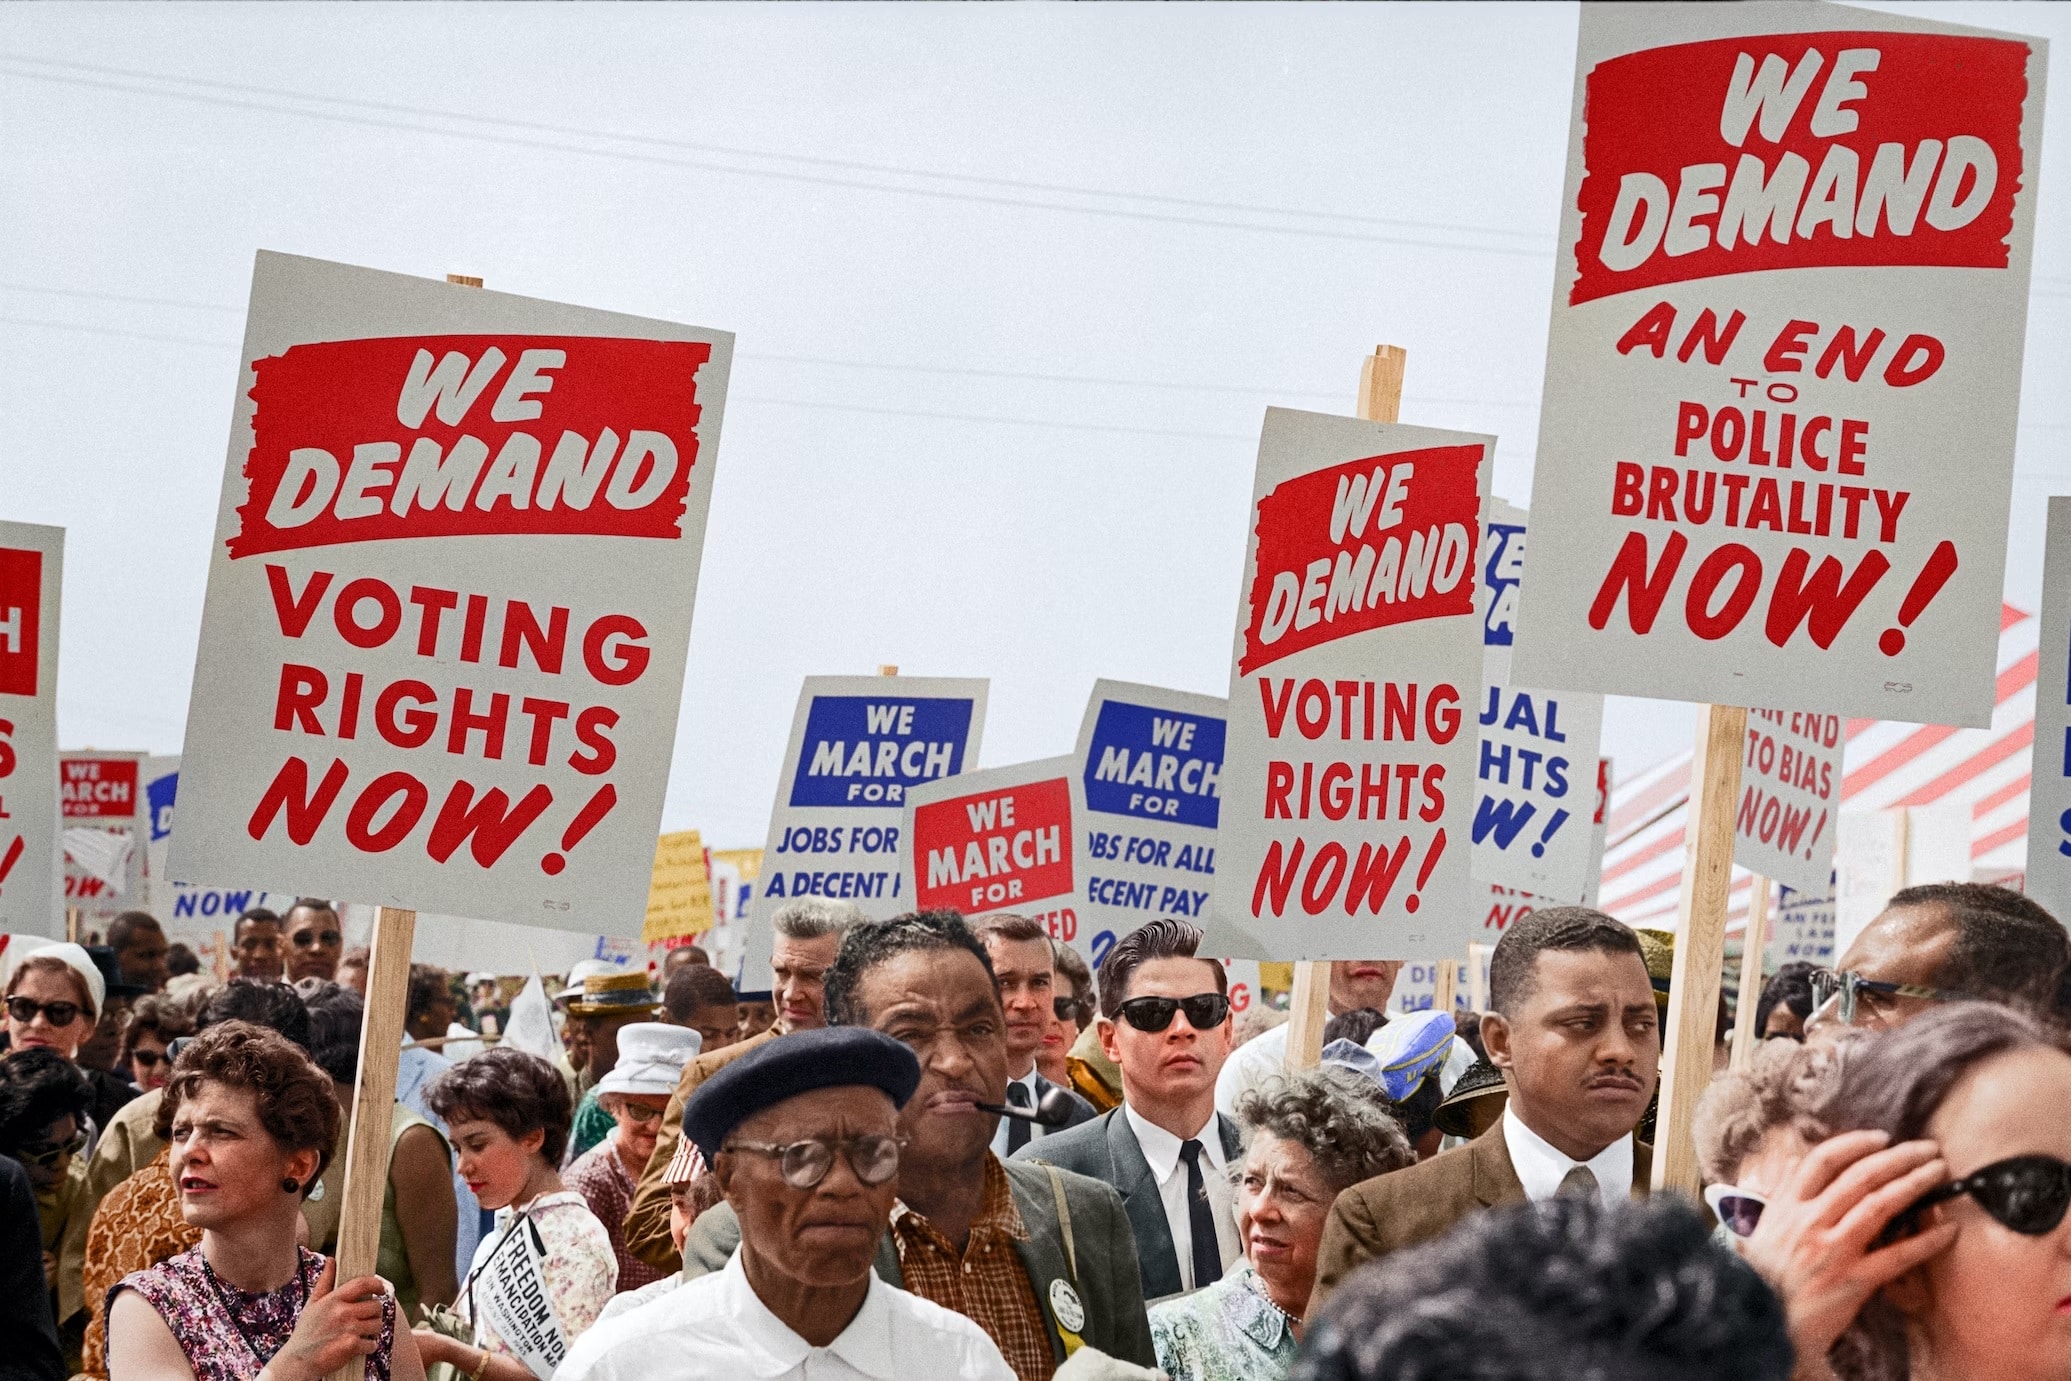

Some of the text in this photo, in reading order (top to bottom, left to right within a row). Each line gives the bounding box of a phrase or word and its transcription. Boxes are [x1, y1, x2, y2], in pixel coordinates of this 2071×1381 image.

[1720, 48, 1880, 147] WE
[1598, 135, 1997, 272] DEMAND
[1616, 301, 1945, 388] AN END
[397, 346, 566, 429] WE
[1730, 378, 1798, 403] TO
[1674, 401, 1869, 476] POLICE
[265, 427, 679, 529] DEMAND
[1330, 463, 1414, 544] WE
[1611, 462, 1910, 542] BRUTALITY
[1259, 522, 1469, 645] DEMAND
[1588, 530, 1958, 657] NOW!
[265, 564, 651, 685] VOTING
[273, 664, 621, 775] RIGHTS
[866, 706, 915, 735] WE
[1152, 717, 1196, 751] WE
[1259, 677, 1462, 745] VOTING
[66, 763, 100, 780] WE
[808, 741, 953, 778] MARCH
[848, 784, 904, 801] FOR
[1095, 746, 1223, 798] MARCH
[1265, 761, 1446, 823] RIGHTS
[1750, 730, 1831, 799] TO BIAS
[247, 756, 617, 876] NOW!
[778, 828, 898, 852] JOBS FOR
[966, 796, 1014, 833] WE
[1129, 793, 1179, 816] FOR
[1737, 784, 1830, 861] NOW!
[766, 874, 784, 896] A
[793, 873, 886, 897] DECENT
[928, 825, 1060, 889] MARCH
[1090, 833, 1214, 873] BS FOR ALL
[1251, 828, 1447, 917] NOW!
[971, 879, 1023, 907] FOR
[1161, 888, 1207, 915] PAY
[493, 1252, 548, 1352] EMANCIPATION
[506, 1227, 550, 1325] FREEDOM
[486, 1275, 534, 1352] ON WASHINGTON
